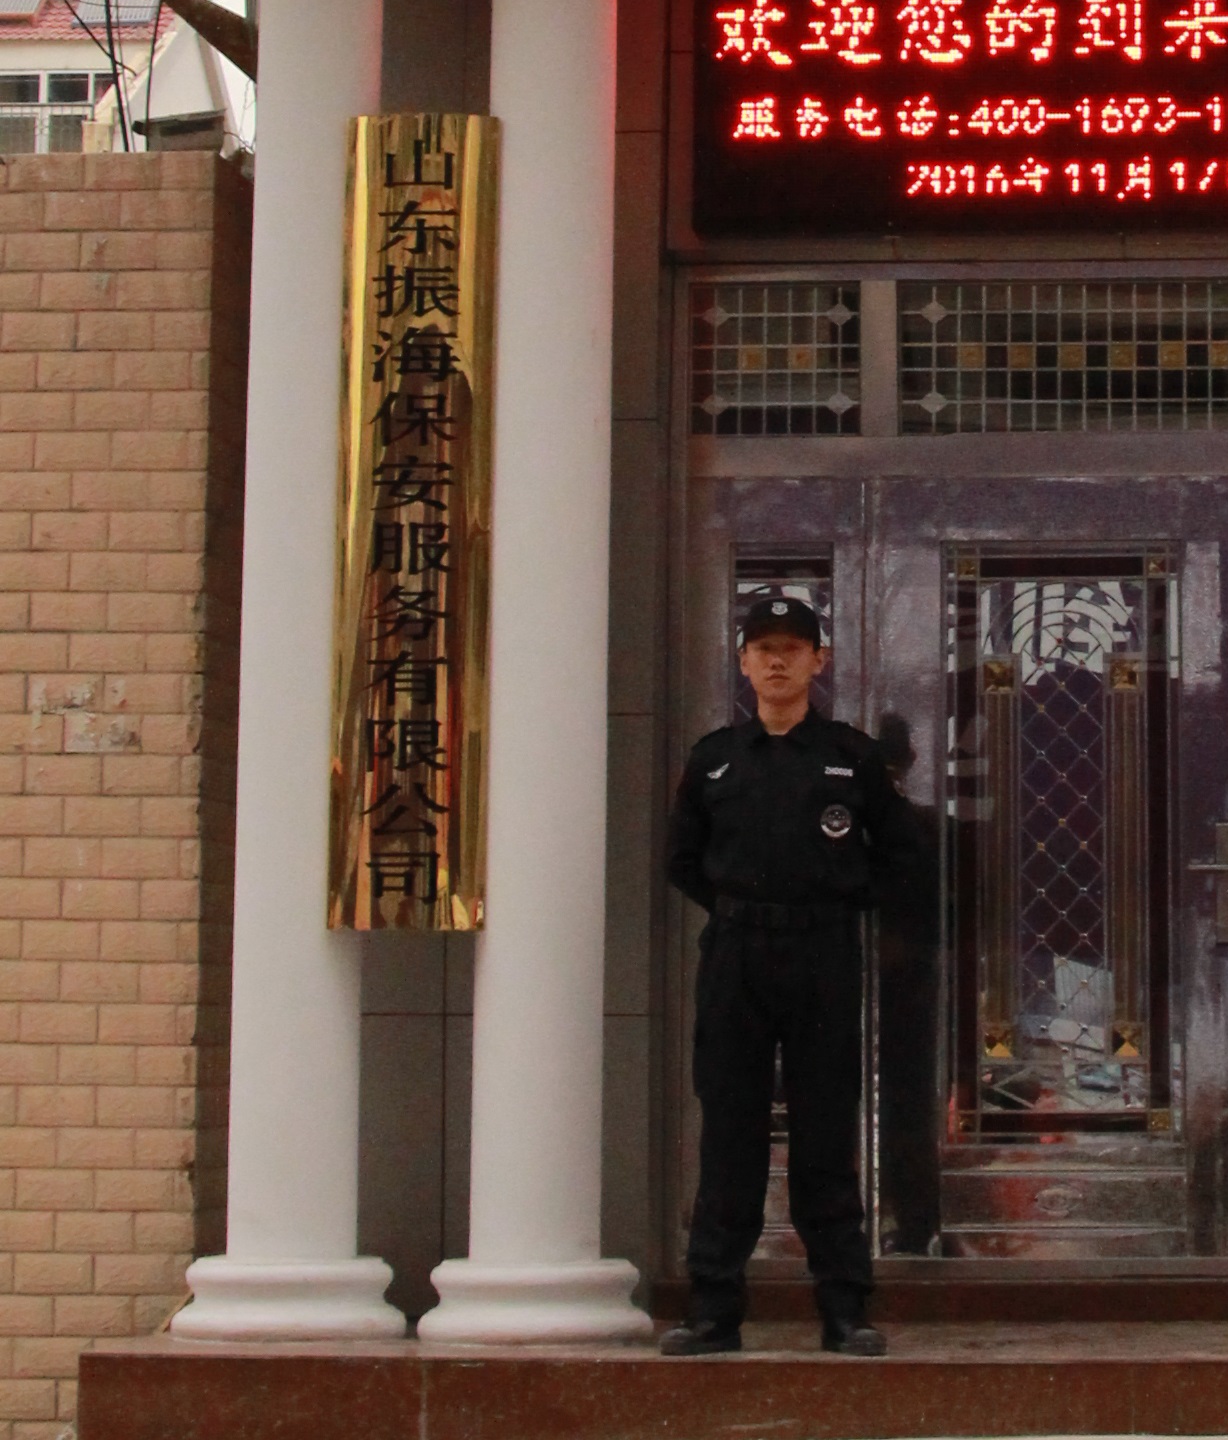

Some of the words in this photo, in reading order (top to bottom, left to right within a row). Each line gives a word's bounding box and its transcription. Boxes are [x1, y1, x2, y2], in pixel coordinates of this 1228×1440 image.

[360, 140, 461, 904] 山东振海保安服务有限公司
